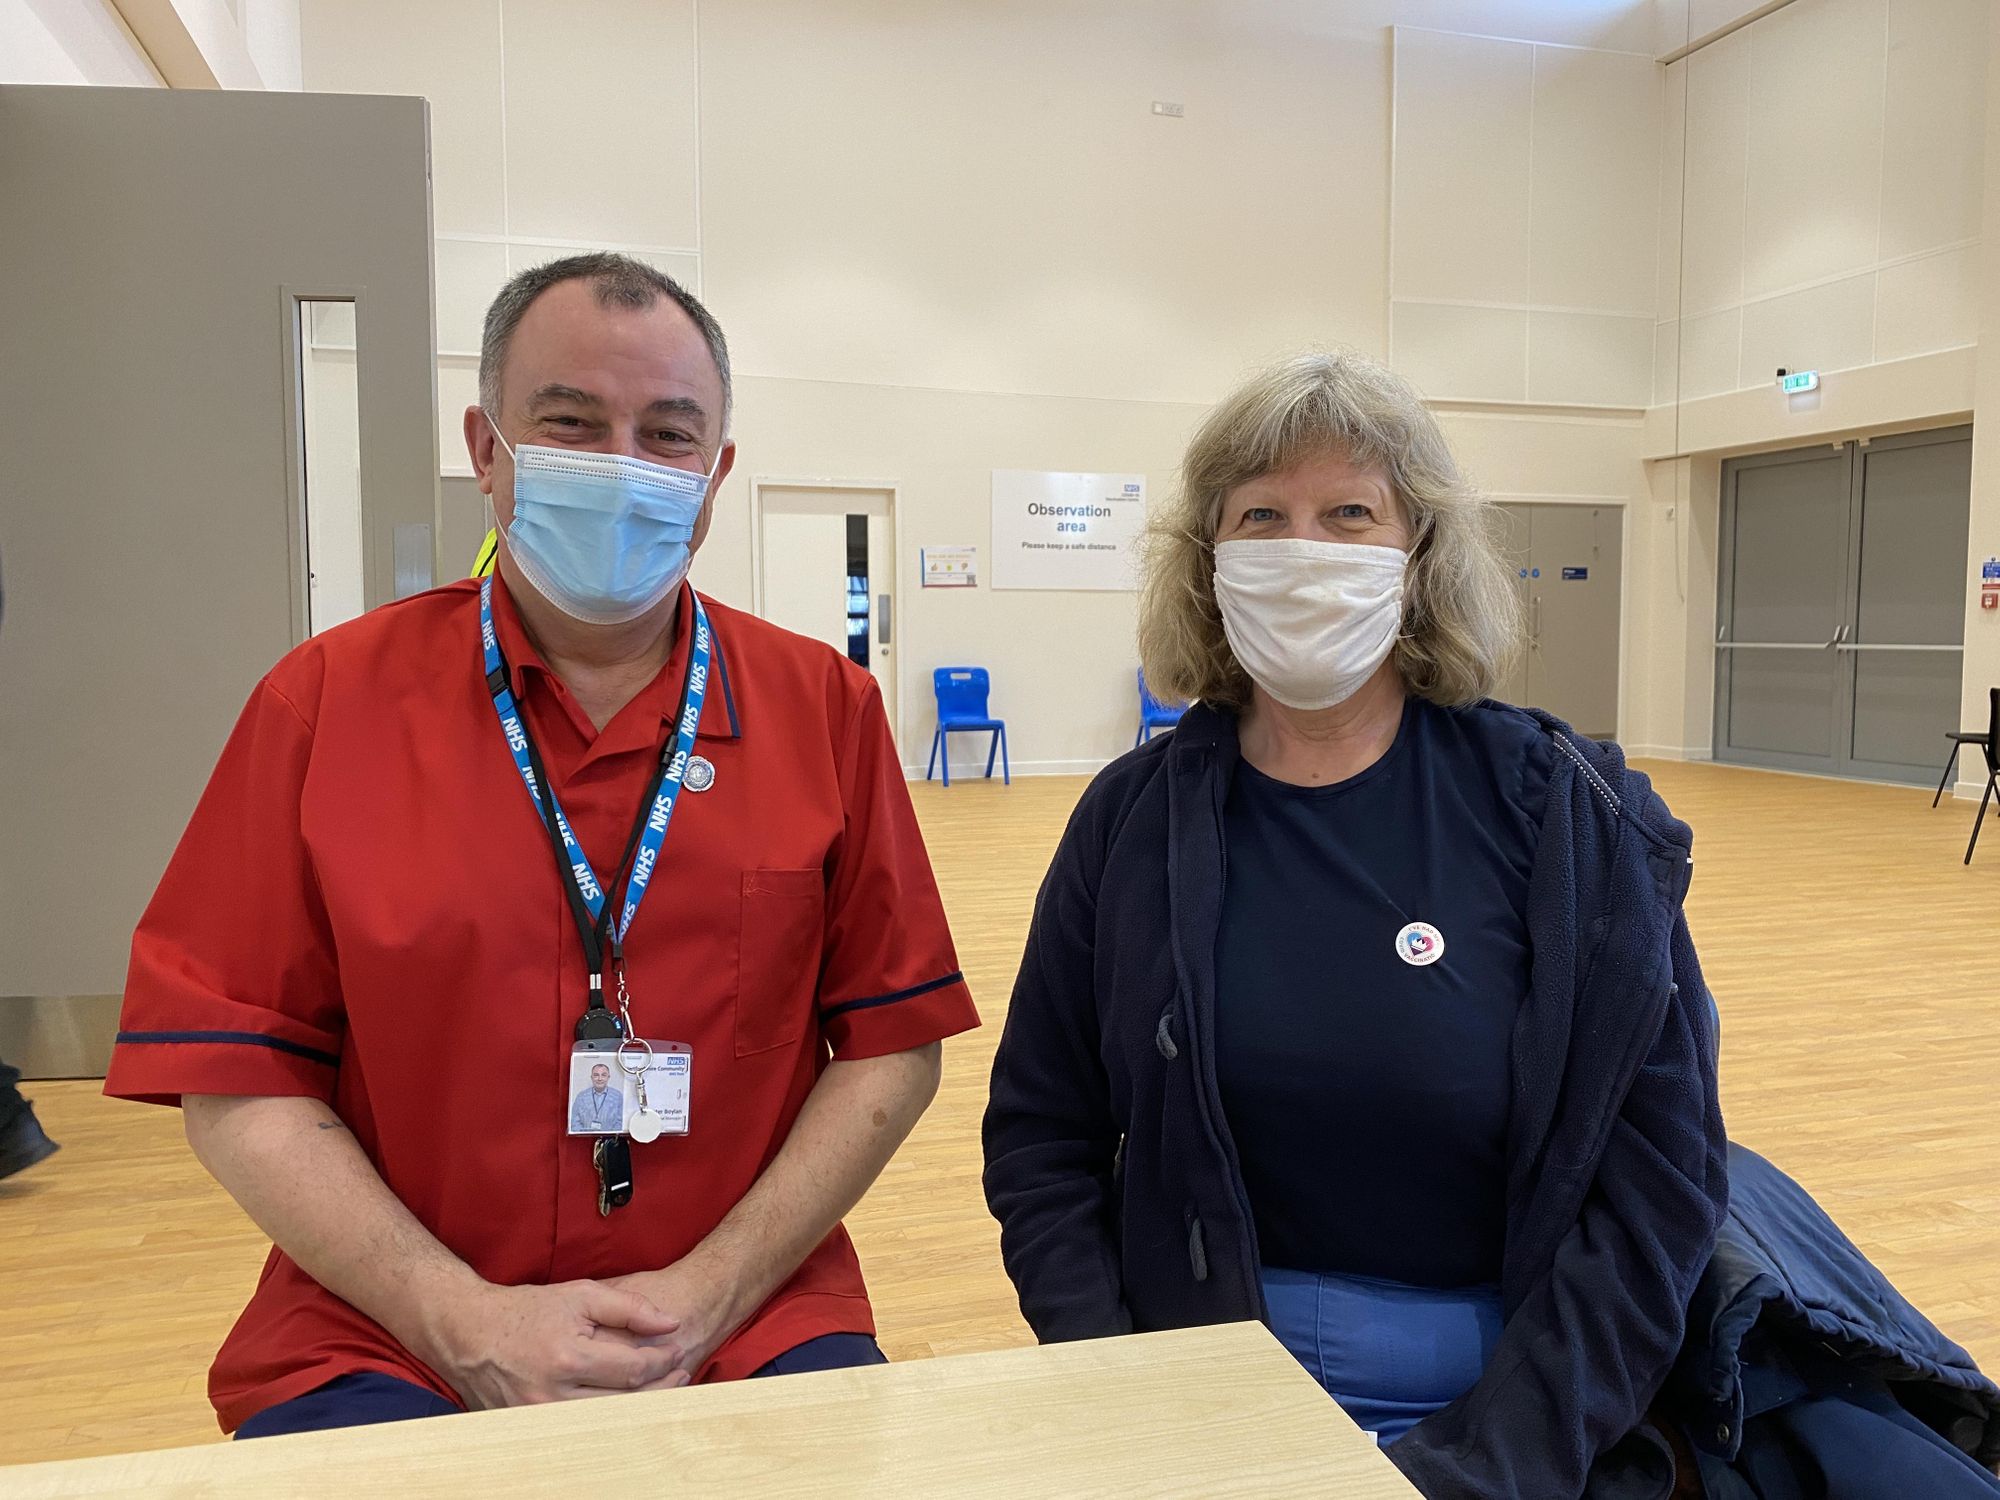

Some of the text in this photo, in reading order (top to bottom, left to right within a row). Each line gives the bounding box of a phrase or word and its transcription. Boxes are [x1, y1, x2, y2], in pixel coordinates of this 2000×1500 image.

[1028, 503, 1111, 517] Observation
[1057, 522, 1086, 532] area
[482, 619, 495, 651] NHS
[697, 622, 709, 655] NHS
[690, 662, 706, 696] NHS
[503, 716, 528, 753] NHS
[681, 705, 699, 739] NHS
[665, 750, 688, 784] NHS
[649, 794, 672, 833] NHS
[572, 863, 600, 901] NHS
[633, 845, 656, 888] NHS
[1404, 953, 1435, 962] VACCINATIO
[667, 1057, 685, 1065] NHS
